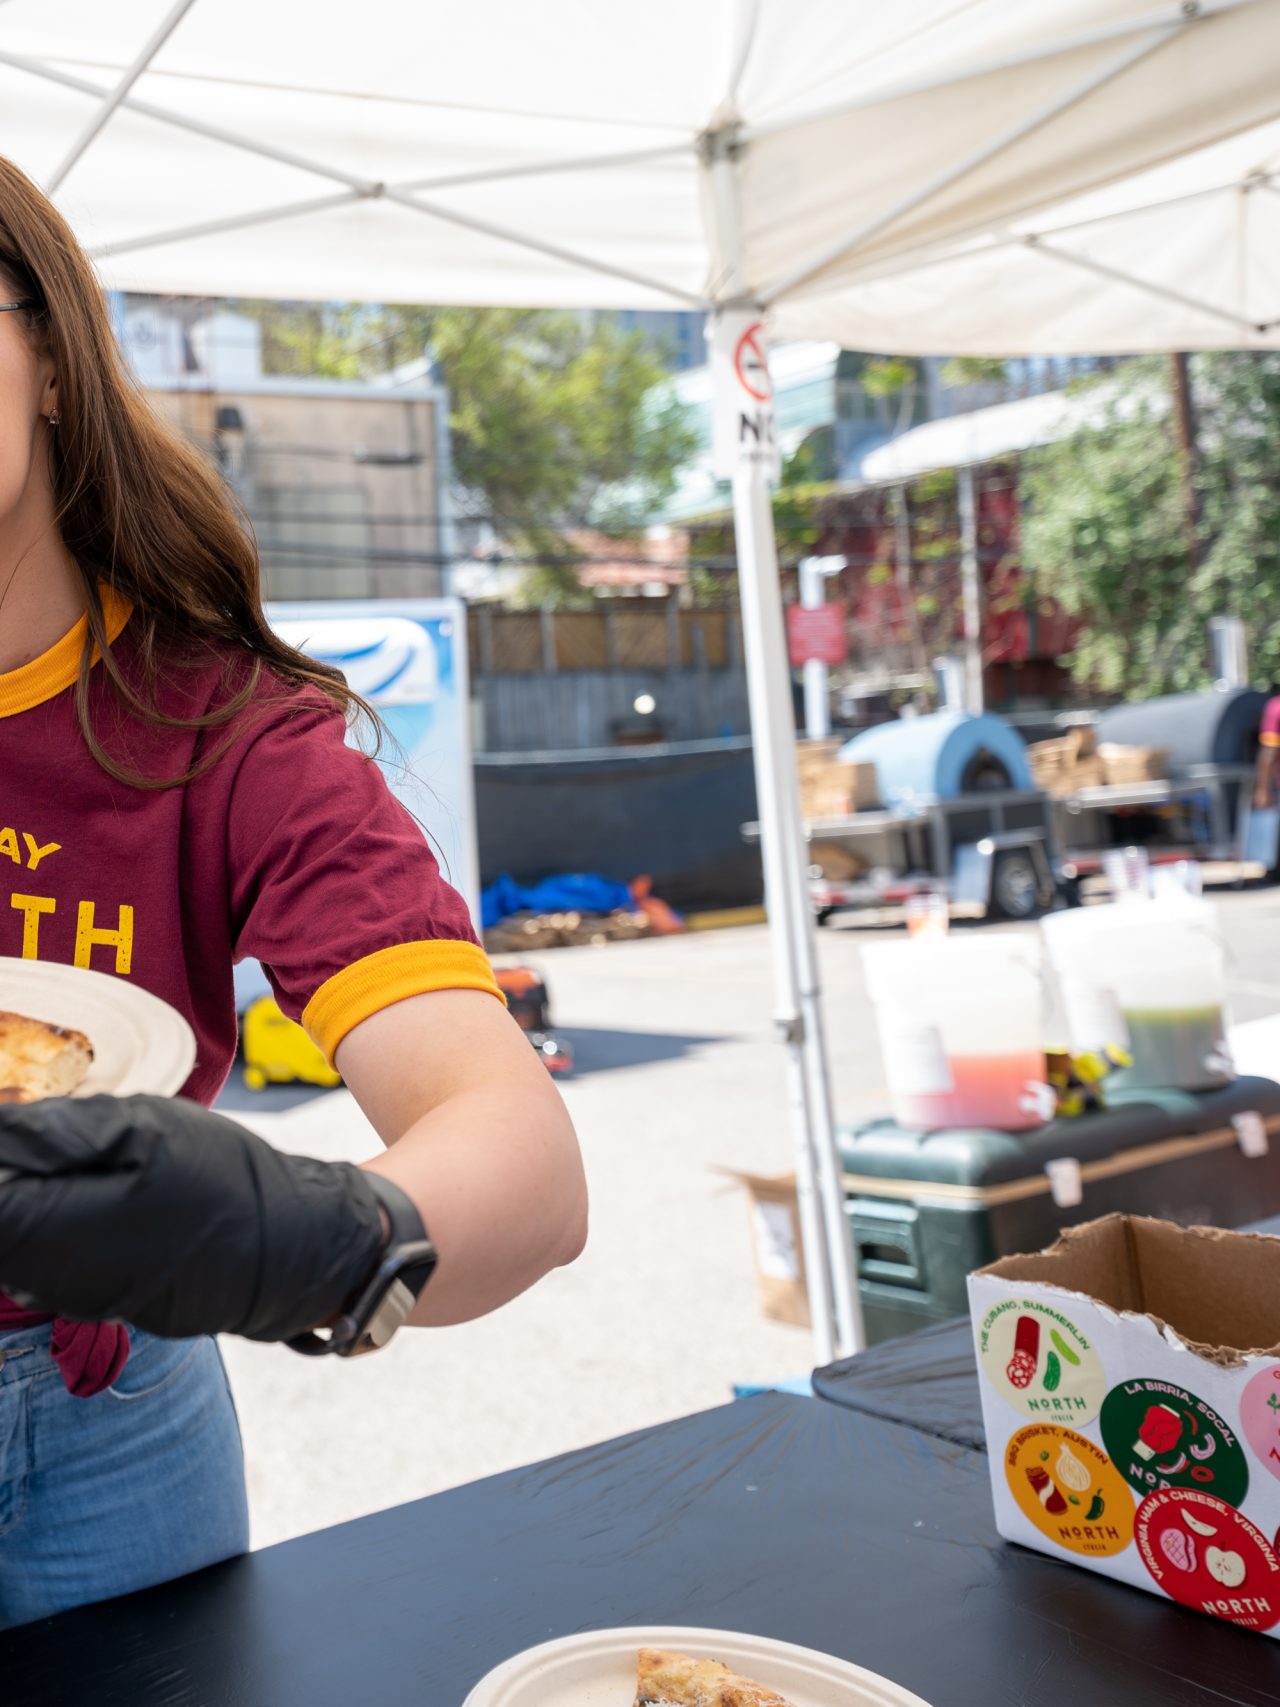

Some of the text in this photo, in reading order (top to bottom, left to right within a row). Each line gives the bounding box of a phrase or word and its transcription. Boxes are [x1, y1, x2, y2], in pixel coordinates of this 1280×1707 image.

[981, 1330, 989, 1353] THE
[1028, 1397, 1087, 1412] NORTH
[1124, 1381, 1235, 1448] LA BIRRIA, SOCAL
[1063, 1431, 1109, 1465] AUSTIN
[1058, 1526, 1120, 1540] NORTH
[1140, 1498, 1160, 1522] HAM
[1158, 1494, 1170, 1504] &
[1234, 1513, 1279, 1572] VIRGINIA
[1202, 1597, 1271, 1615] NORTH
